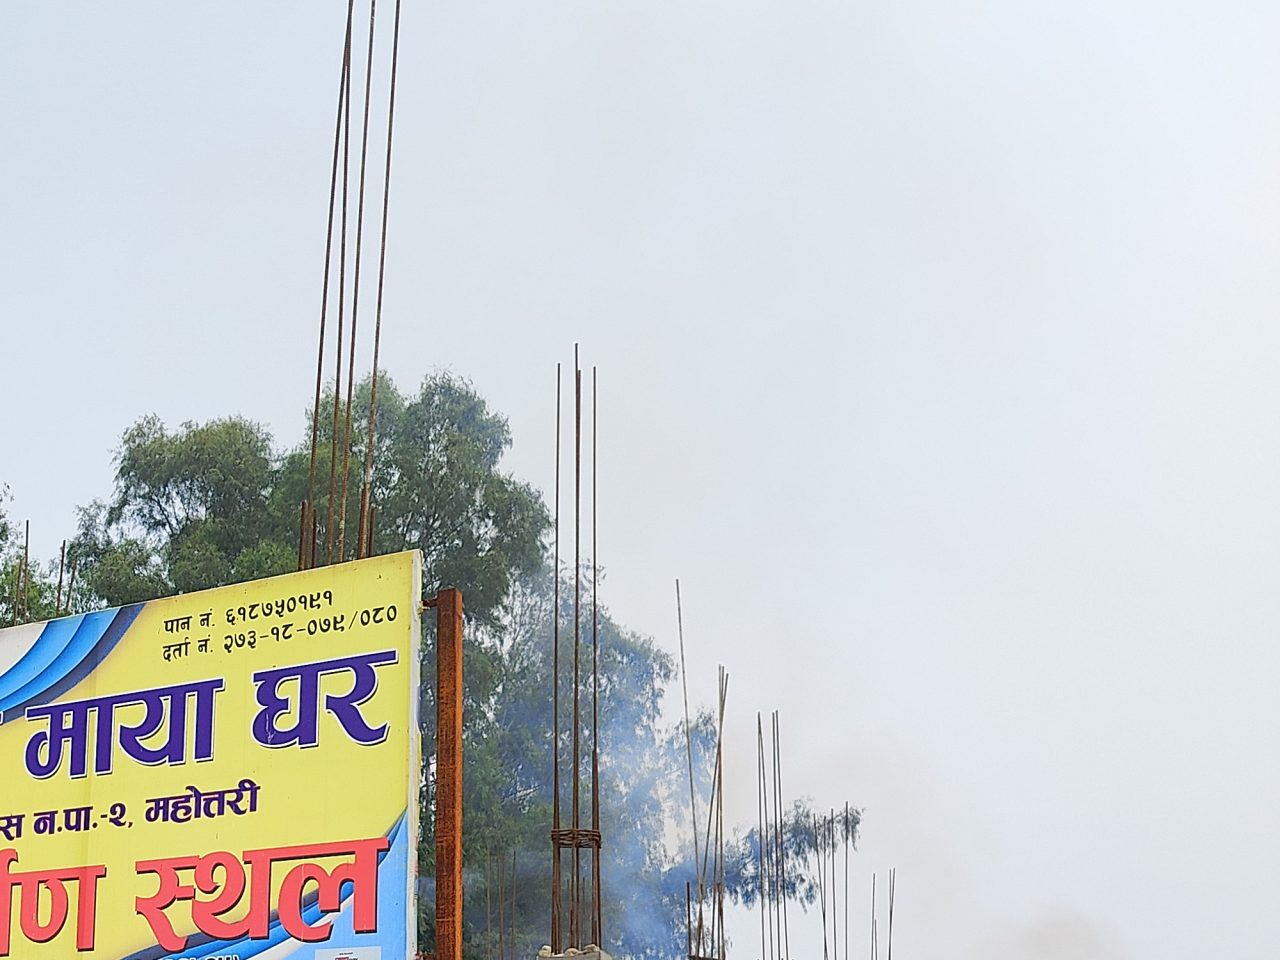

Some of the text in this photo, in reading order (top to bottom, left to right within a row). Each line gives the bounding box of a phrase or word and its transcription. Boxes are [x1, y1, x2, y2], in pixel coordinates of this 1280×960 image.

[163, 615, 193, 634] पान
[225, 590, 333, 626] ६१८७५०१९१
[162, 637, 191, 661] दर्ता
[25, 678, 223, 778] माया
[252, 650, 398, 748] घर
[145, 780, 261, 823] महोत्तरी
[134, 836, 391, 953] स्थल
